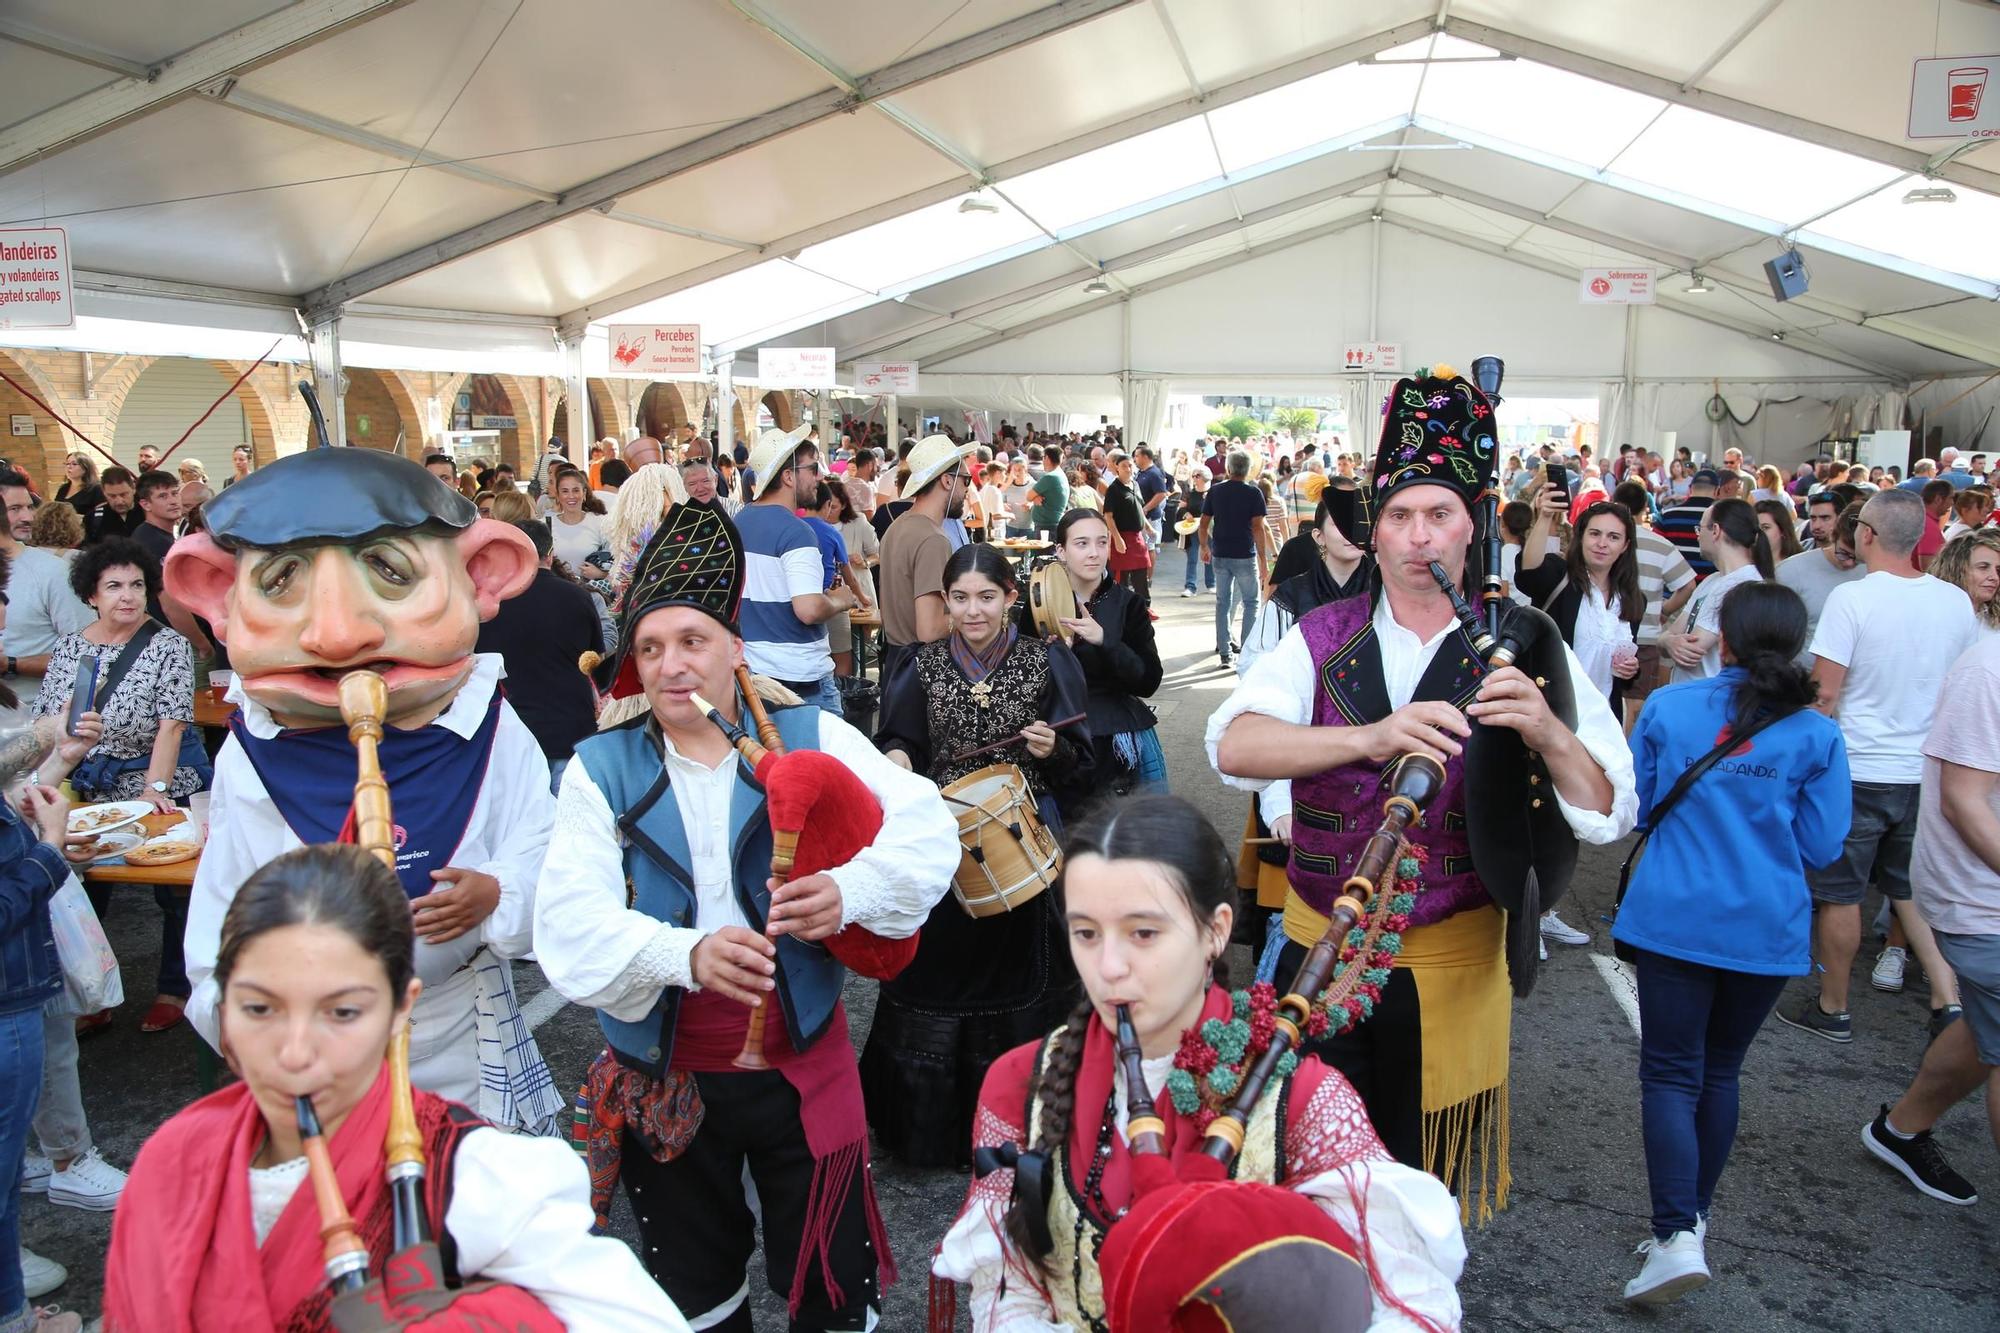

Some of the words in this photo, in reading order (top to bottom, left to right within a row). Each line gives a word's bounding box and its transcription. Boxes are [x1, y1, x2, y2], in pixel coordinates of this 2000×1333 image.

[0, 241, 57, 261] landeiras
[8, 268, 59, 282] volandeiras
[0, 288, 24, 306] gated
[25, 287, 61, 304] scallops
[655, 328, 695, 342] Percebes
[671, 345, 695, 353] Percebes
[1685, 757, 1778, 779] PADANDA
